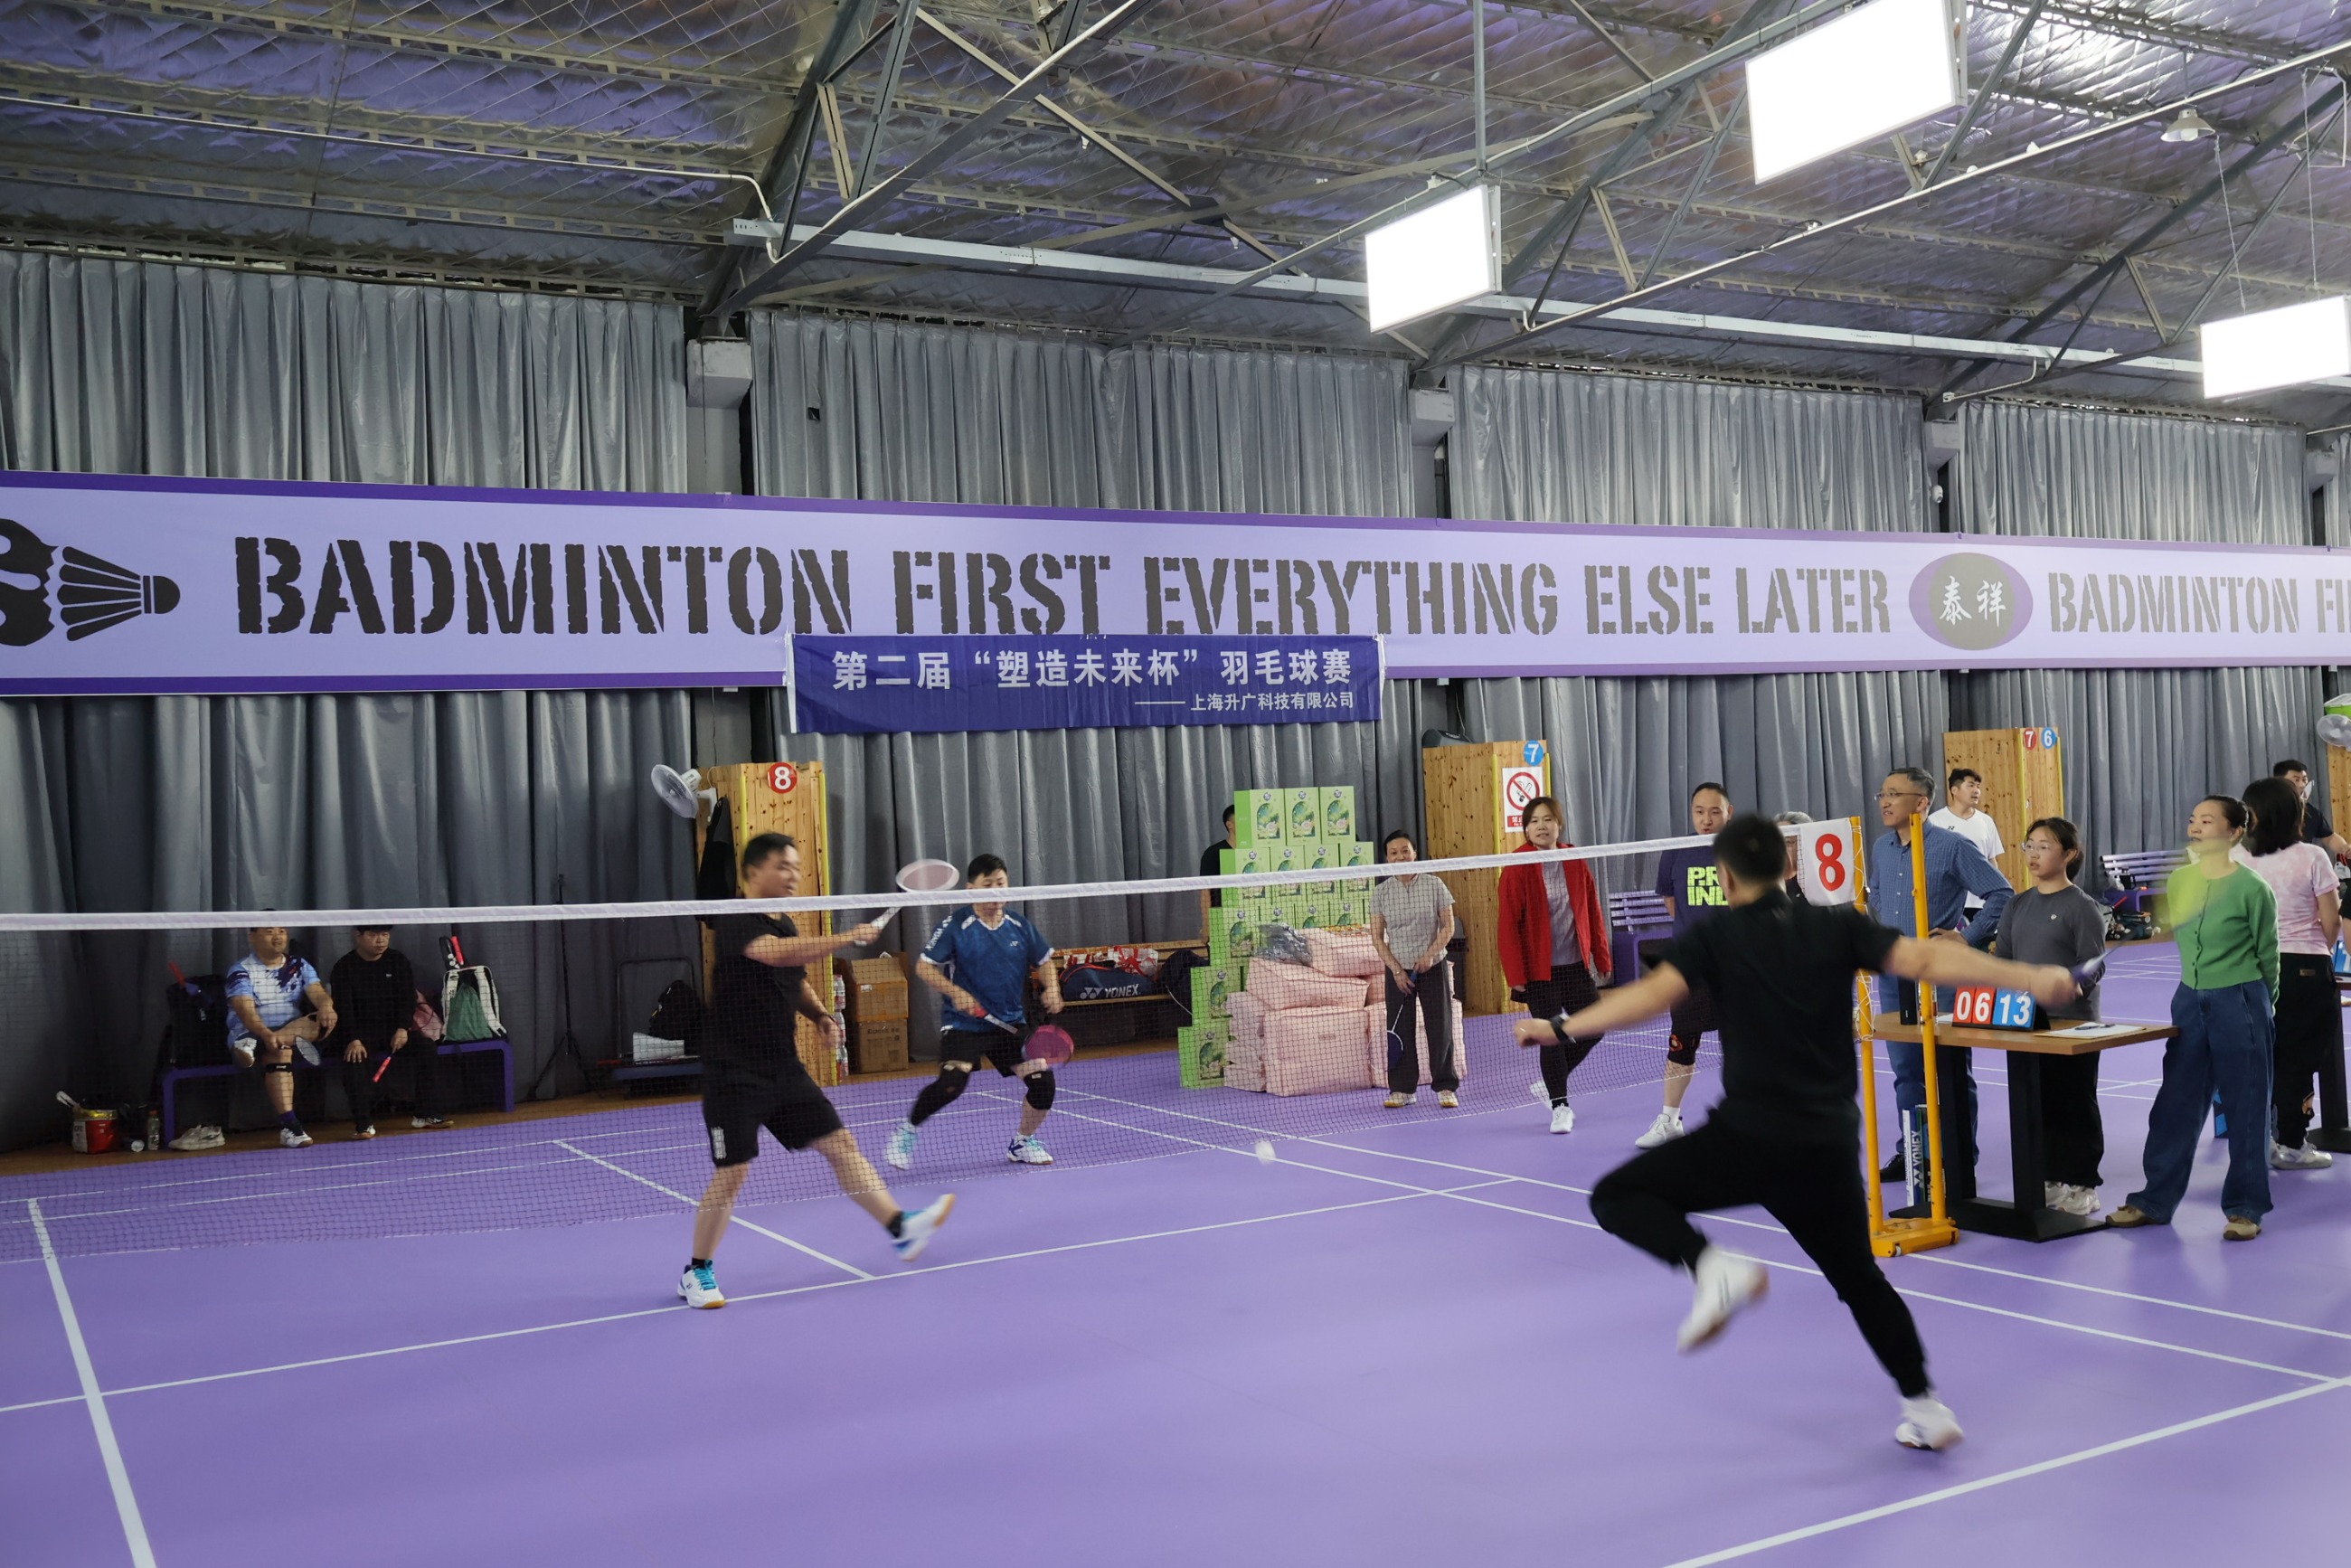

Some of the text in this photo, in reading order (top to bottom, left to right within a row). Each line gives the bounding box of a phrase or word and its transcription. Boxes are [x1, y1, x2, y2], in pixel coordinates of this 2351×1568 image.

[236, 536, 1891, 636] BADMINTON FIRST EVERYTHING ELSE LATER
[1939, 575, 2006, 628] 泰祥
[2048, 572, 2351, 634] BADMINTON FI
[832, 650, 950, 690] 第二届
[1220, 648, 1352, 685] 羽毛球赛
[1527, 743, 1539, 763] 7
[2025, 731, 2035, 748] 7
[2044, 730, 2053, 747] 6
[774, 766, 792, 790] 8
[1815, 833, 1846, 893] 8
[1104, 983, 1140, 998] YONEX
[1956, 991, 2032, 1025] 06 13
[1911, 1129, 1925, 1167] YONEX
